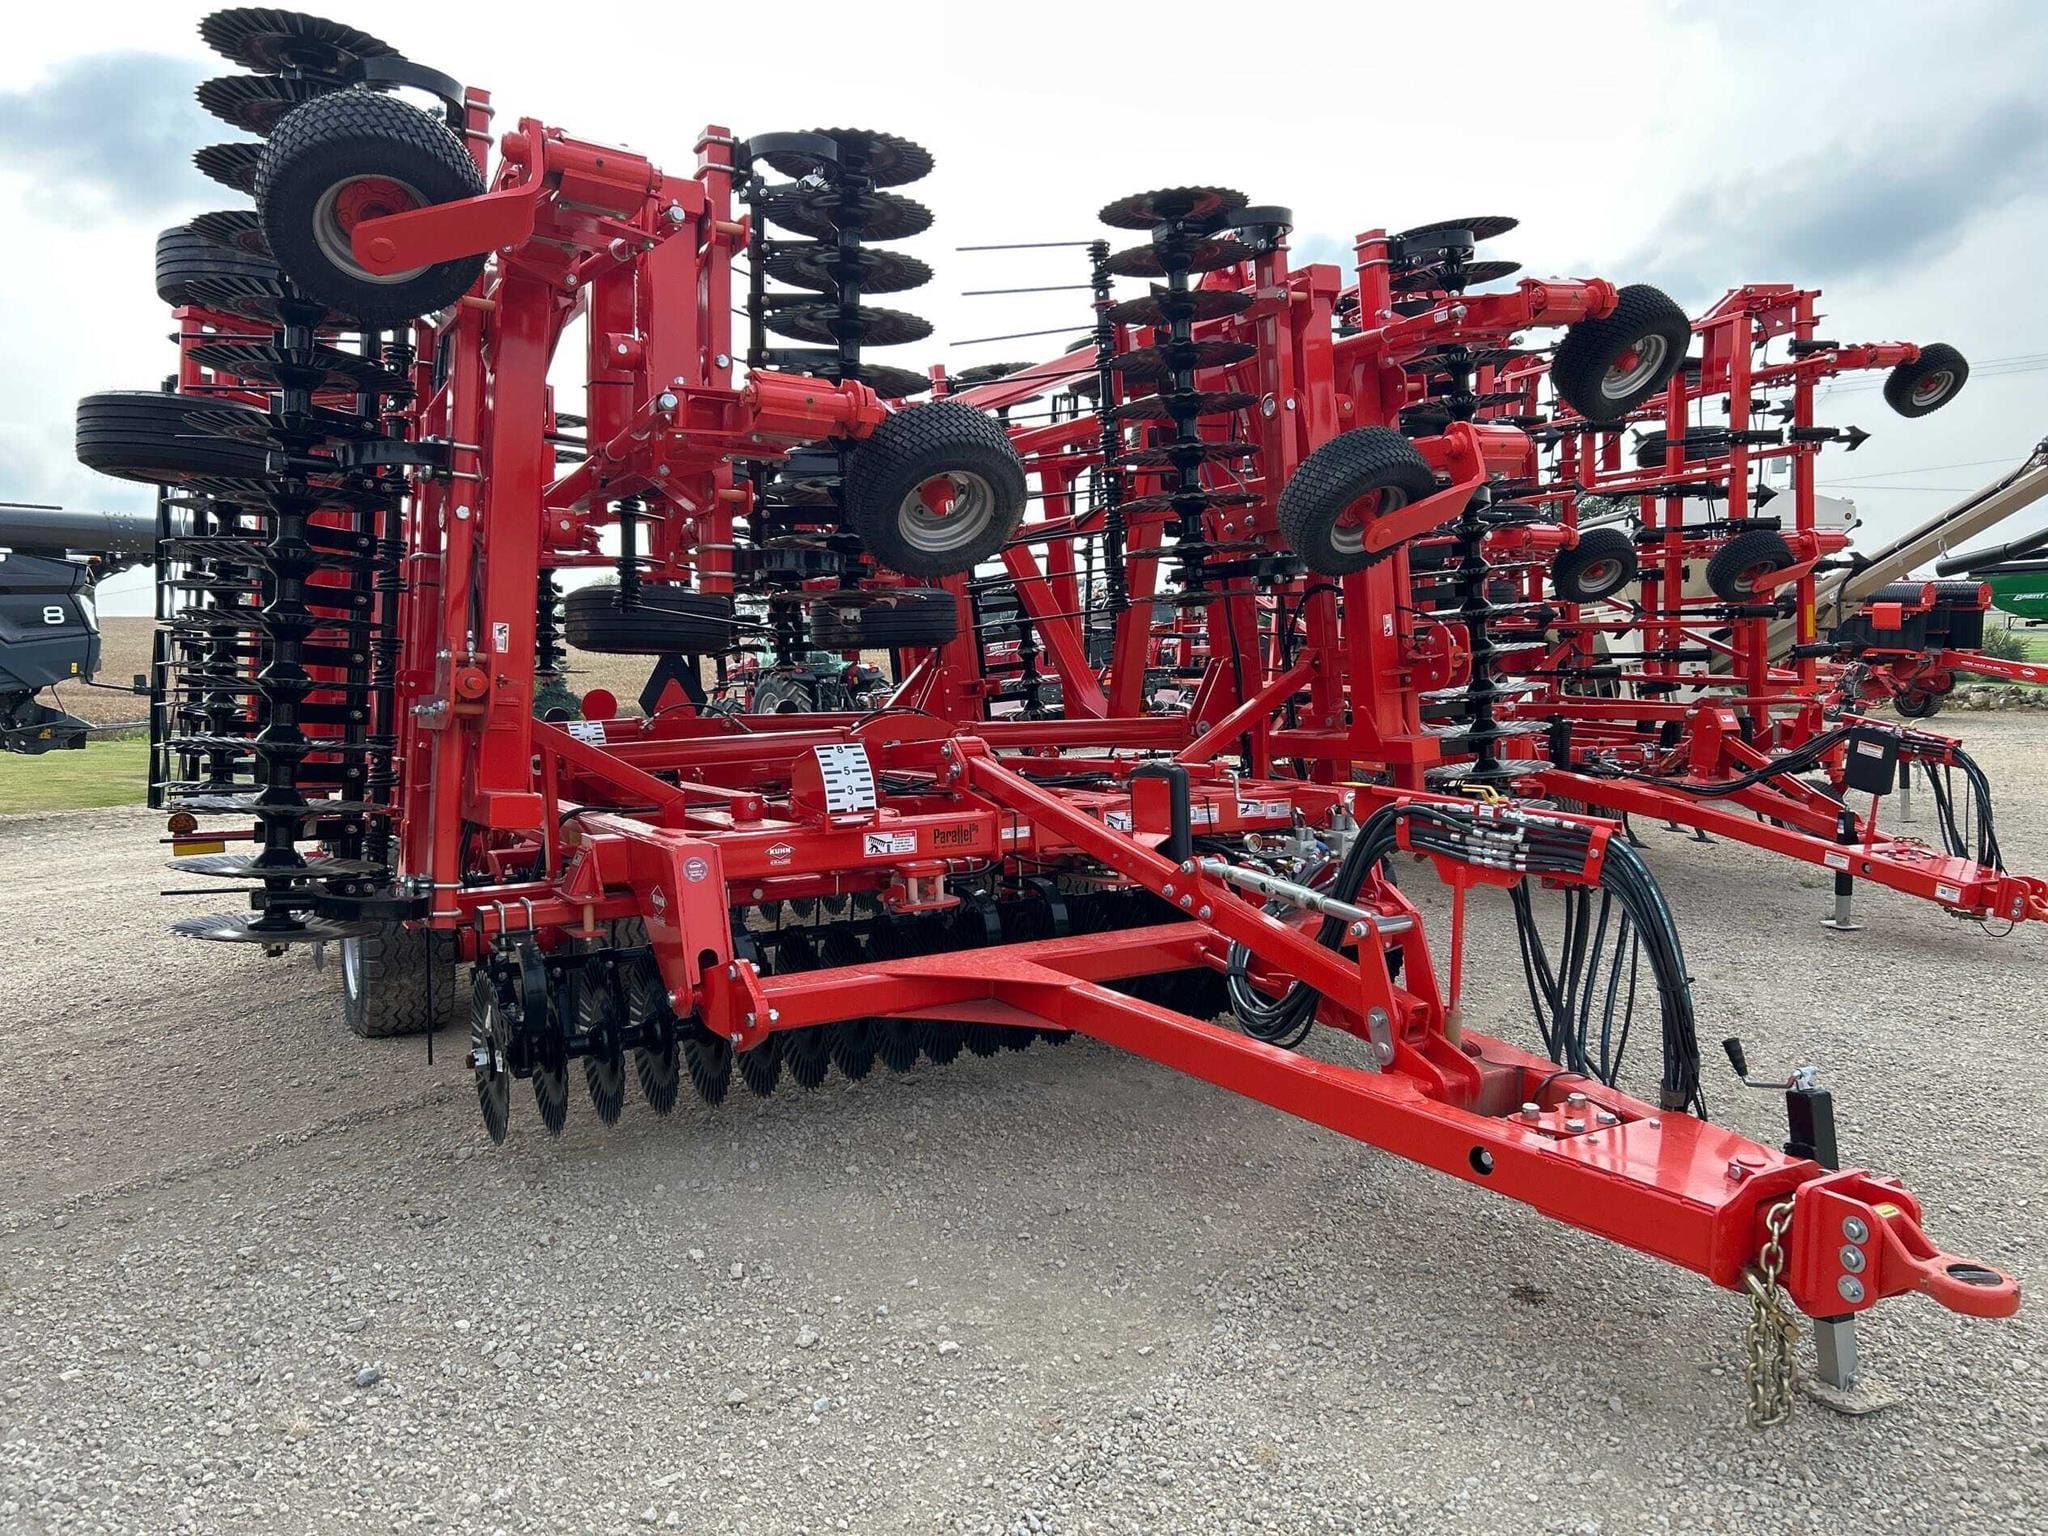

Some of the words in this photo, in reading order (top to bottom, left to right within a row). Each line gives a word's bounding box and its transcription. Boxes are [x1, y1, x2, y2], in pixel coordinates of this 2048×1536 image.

[43, 605, 65, 624] 8
[586, 735, 592, 743] 5
[836, 745, 844, 754] 8
[843, 766, 851, 776] 5
[847, 785, 854, 796] 3
